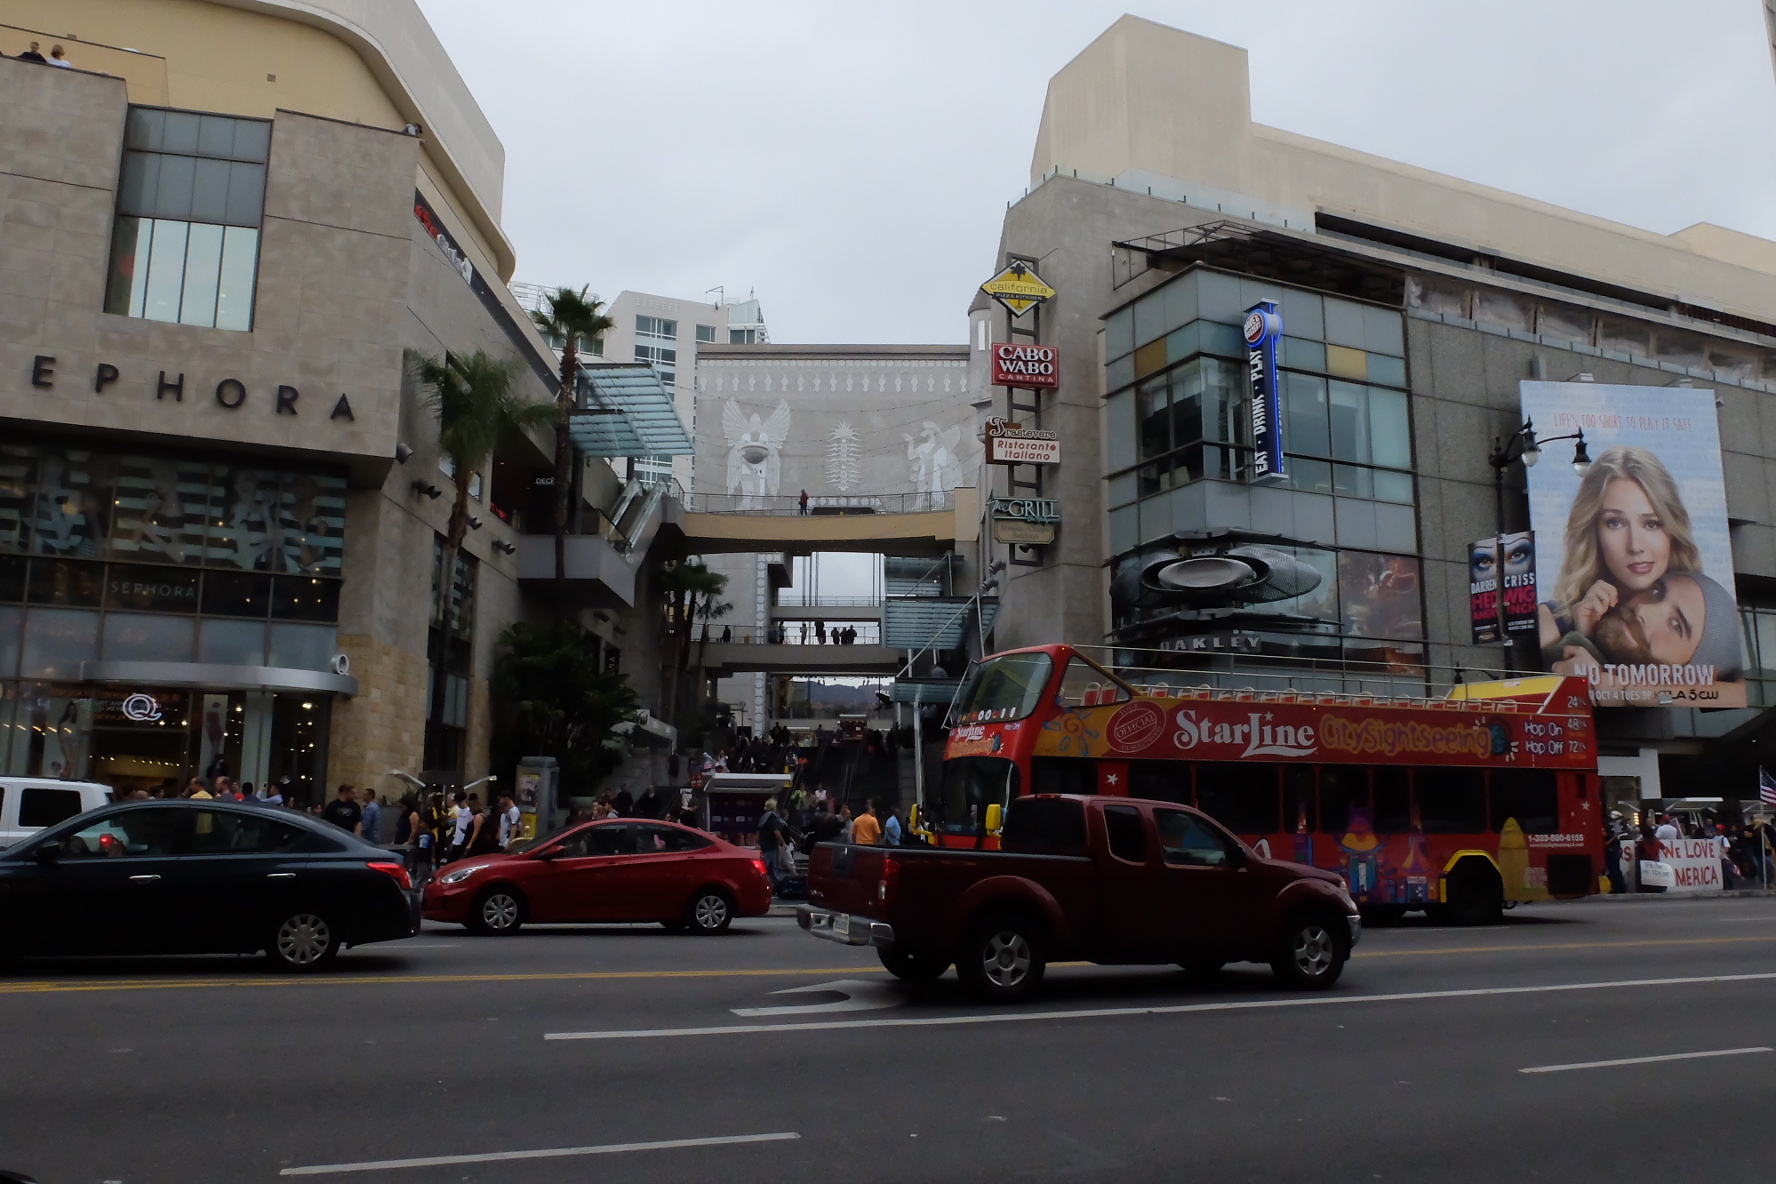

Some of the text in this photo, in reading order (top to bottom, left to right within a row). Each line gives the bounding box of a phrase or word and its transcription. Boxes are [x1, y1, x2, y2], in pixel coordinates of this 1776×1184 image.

[990, 283, 1047, 294] california
[998, 346, 1053, 362] CABO
[999, 360, 1053, 375] WABO
[998, 373, 1055, 383] CANTINA
[31, 354, 356, 422] EPHORA
[1249, 350, 1268, 474] EAT DRINK PLAY
[989, 416, 1056, 439] Trastevere
[1554, 413, 1693, 432] LIFE'S TOO SHORT TO PLAY IT SAFE
[1008, 500, 1060, 517] GRILL
[1470, 578, 1498, 595] DARREN
[1504, 572, 1535, 588] CRISS
[110, 581, 195, 598] SEPHORA
[1160, 637, 1260, 651] OAKLEY
[1574, 663, 1715, 686] NO TOMORROW
[1567, 695, 1578, 708] 24
[1596, 691, 1611, 700] OCT
[1612, 691, 1619, 700] 4
[1621, 691, 1640, 700] TUES
[122, 694, 162, 721] Q
[1118, 703, 1139, 716] TOUR
[1116, 713, 1155, 738] OFFICIAL
[1524, 721, 1564, 737] Hop On
[1567, 717, 1580, 731] 48
[1173, 709, 1319, 758] StarLine
[1319, 713, 1492, 760] CitySightseeing
[1525, 740, 1565, 755] Hop Off
[1568, 740, 1578, 753] 72
[1685, 841, 1715, 859] LOVE
